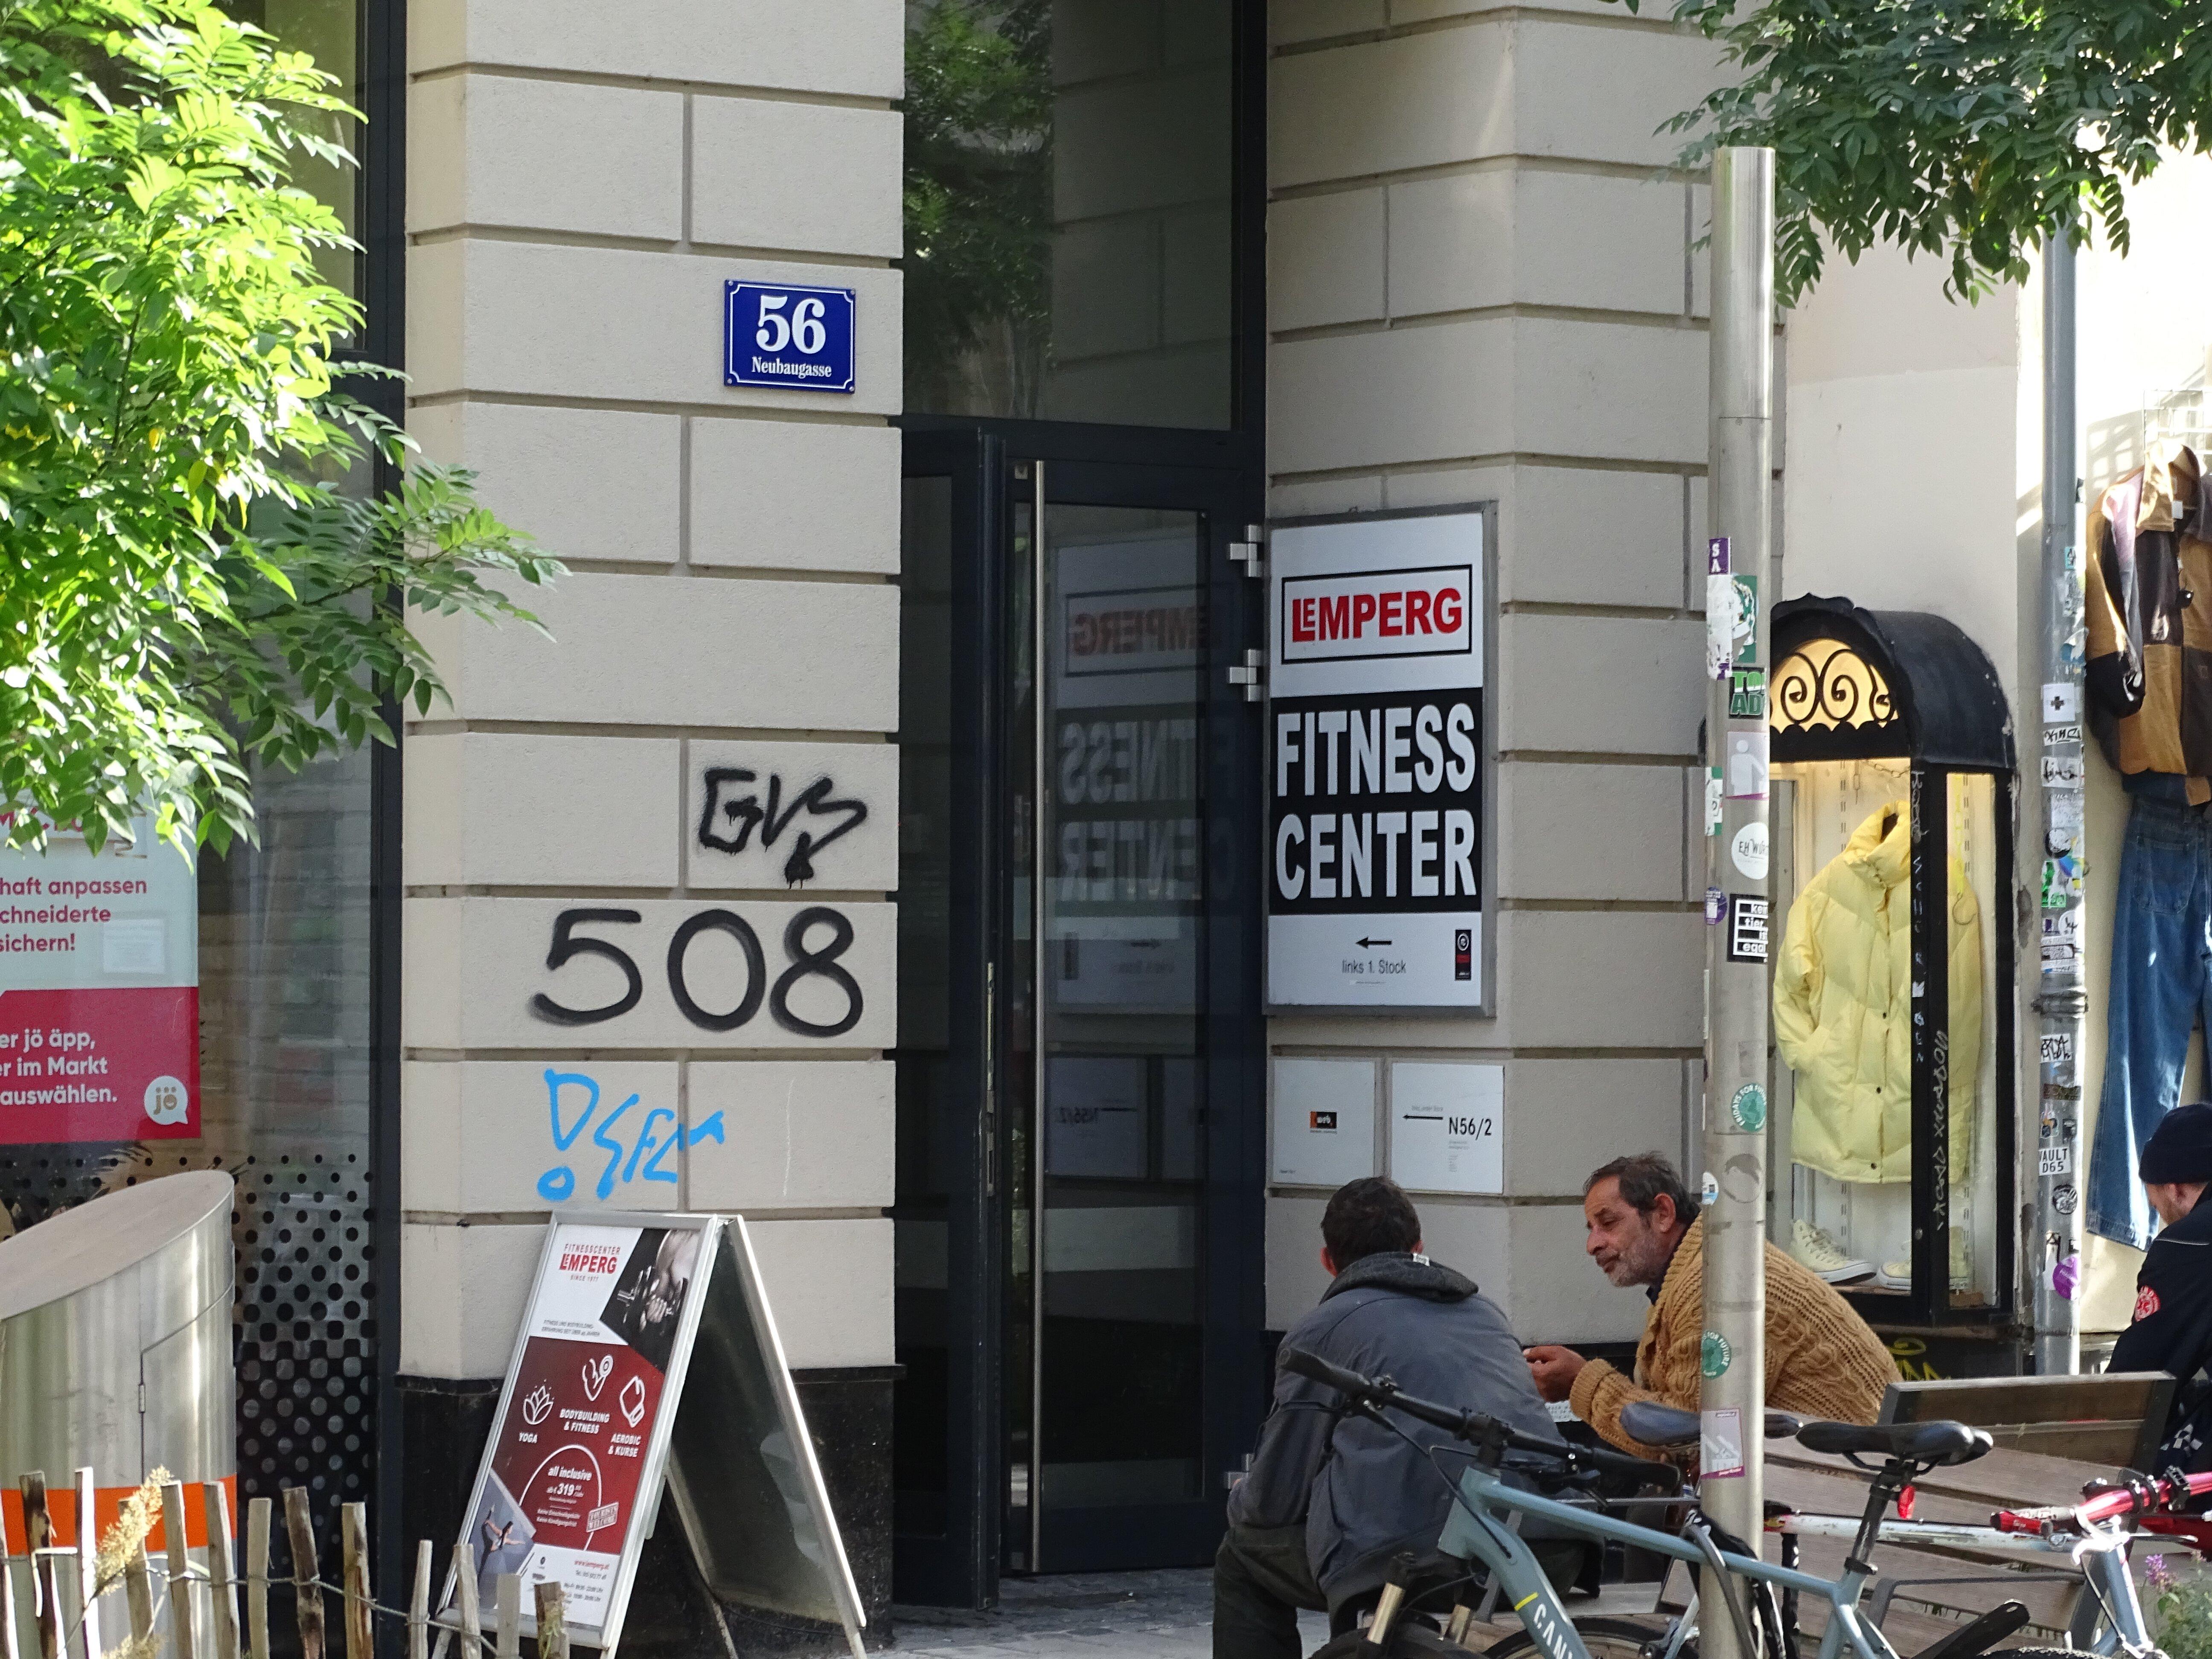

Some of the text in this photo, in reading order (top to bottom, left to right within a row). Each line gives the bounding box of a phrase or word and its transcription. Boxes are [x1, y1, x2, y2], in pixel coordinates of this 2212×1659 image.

[756, 295, 826, 354] 56
[752, 356, 832, 379] Neubaugasse
[1292, 588, 1462, 642] LEMPERG
[1278, 702, 1475, 797] FITNESS
[1276, 809, 1476, 900] CENTER
[48, 880, 147, 899] anpassen
[531, 907, 863, 1038] 508
[1342, 959, 1364, 974] links
[1378, 959, 1406, 974] Stock
[23, 1028, 43, 1053] jö
[49, 1028, 96, 1051] äpp,
[17, 1057, 42, 1076] im
[47, 1055, 108, 1076] Markt
[0, 1084, 118, 1106] auswählen.
[153, 1087, 177, 1115] jö
[1449, 1116, 1492, 1141] N56/2
[565, 1243, 621, 1255] FITNESSCENTER
[559, 1254, 618, 1274] LEMPERG
[559, 1408, 610, 1423] BODYBUILDING
[564, 1421, 600, 1434] & FITNESS
[519, 1432, 538, 1444] YOGA
[611, 1433, 641, 1445] AEROBIC
[608, 1445, 639, 1457] & KURSE
[547, 1465, 593, 1481] all inclusive
[557, 1483, 574, 1496] 319
